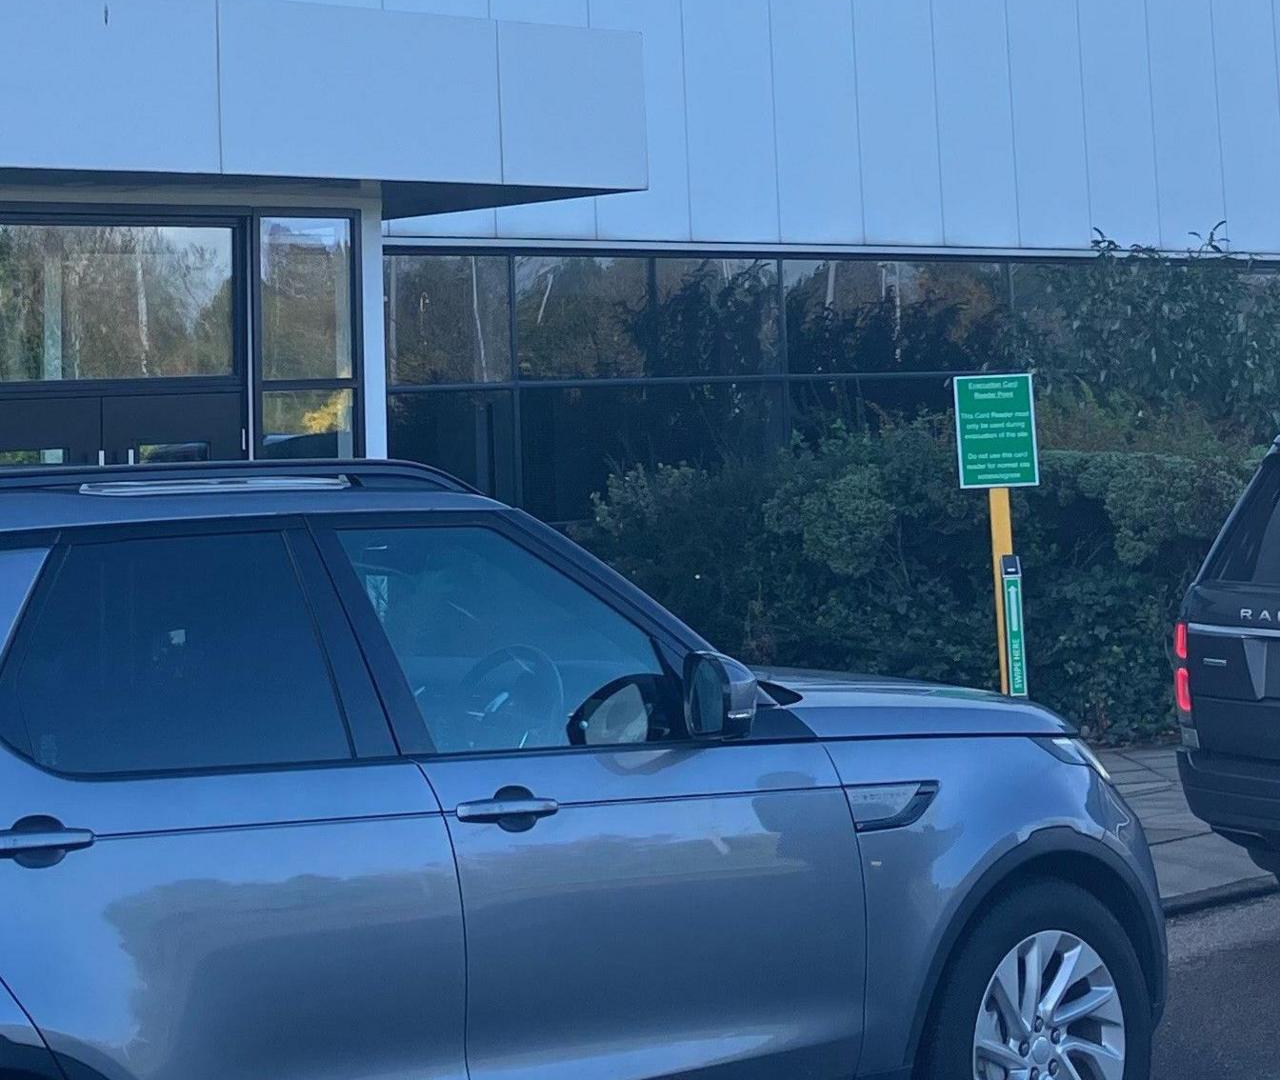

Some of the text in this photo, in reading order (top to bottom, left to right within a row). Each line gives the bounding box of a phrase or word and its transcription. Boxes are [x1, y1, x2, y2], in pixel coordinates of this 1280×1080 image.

[1002, 380, 1018, 388] Card
[1011, 638, 1023, 689] SWIPE HERE
